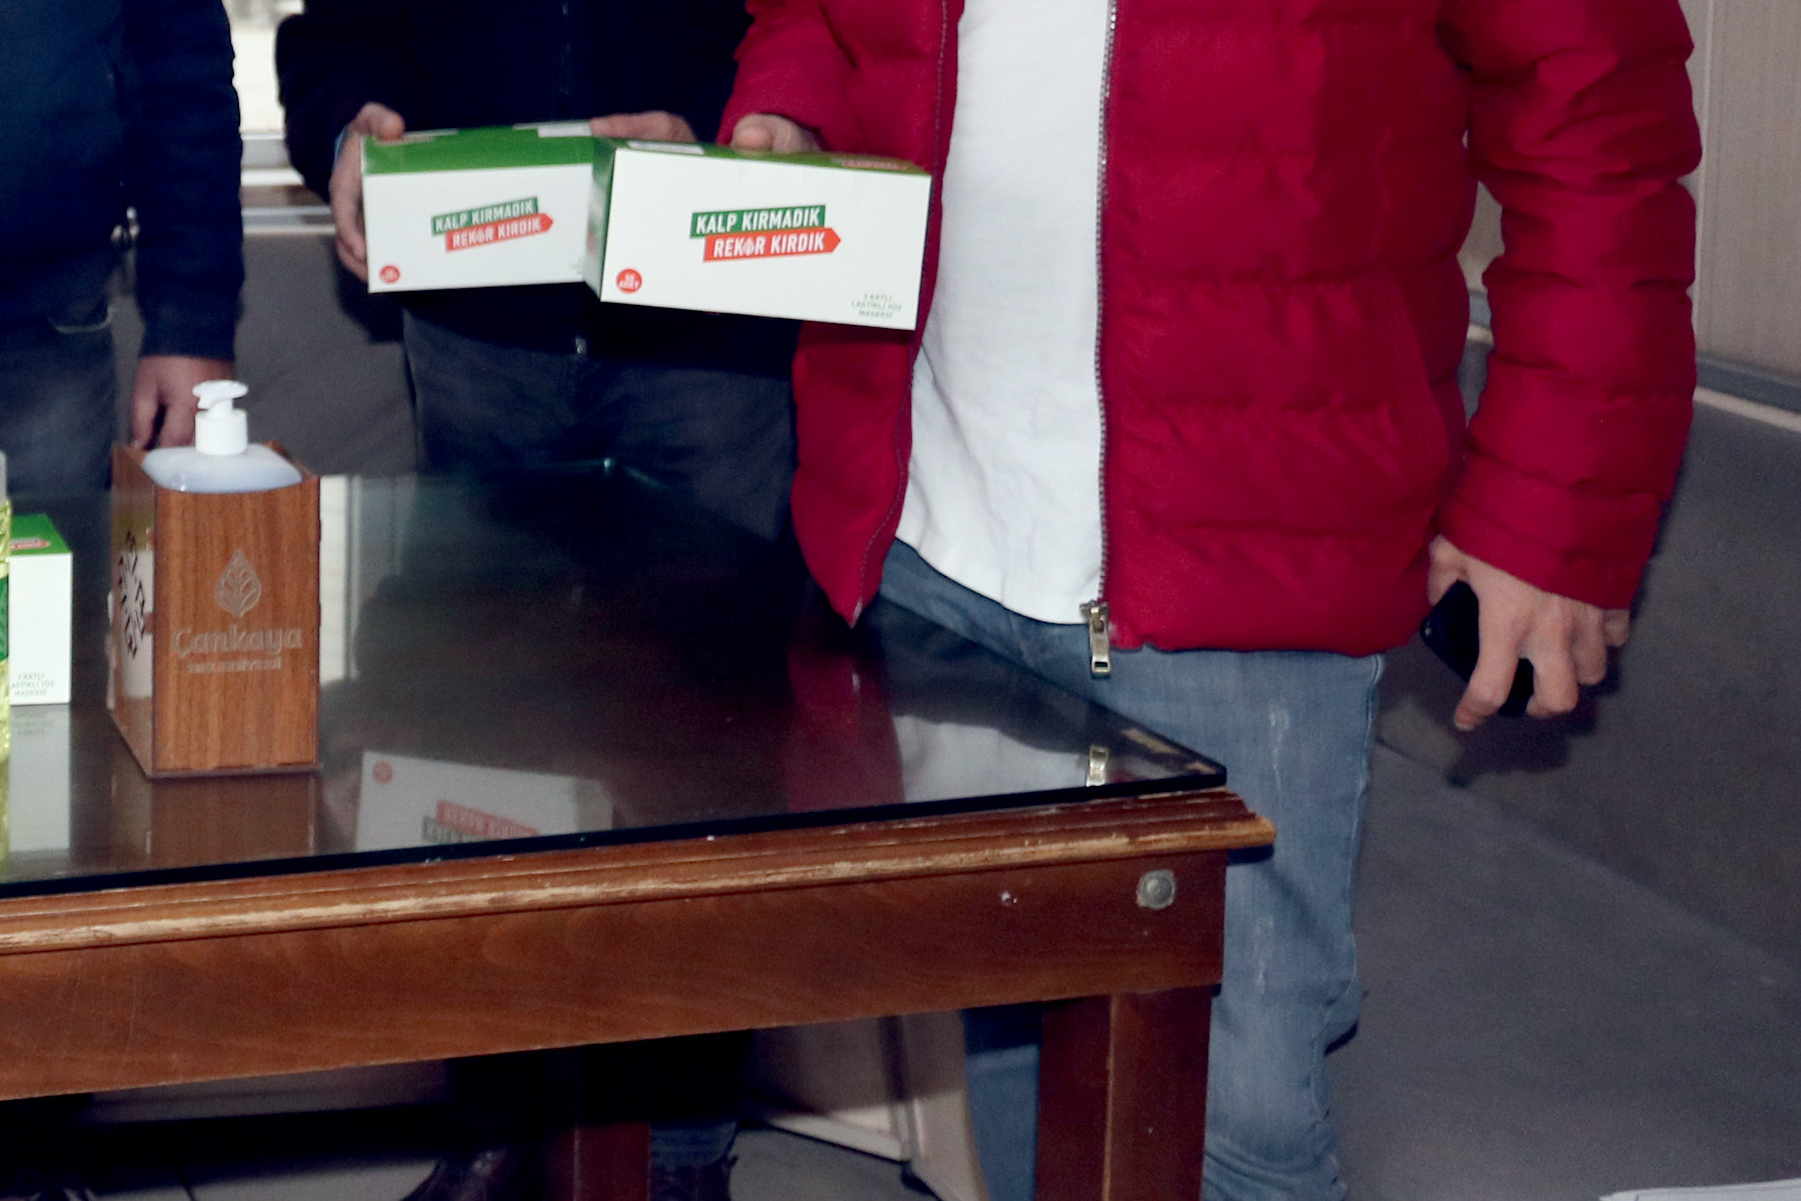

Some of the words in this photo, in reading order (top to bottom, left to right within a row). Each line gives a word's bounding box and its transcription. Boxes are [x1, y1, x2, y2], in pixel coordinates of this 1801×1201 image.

[435, 212, 469, 233] KALP
[471, 199, 535, 226] KIRMADIK
[497, 217, 541, 239] KIRDIK
[695, 213, 738, 235] KALP
[741, 206, 821, 232] KIRMADIK
[712, 235, 767, 259] REKOR
[770, 231, 826, 255] KIRDIK
[171, 624, 303, 658] Çankaya
